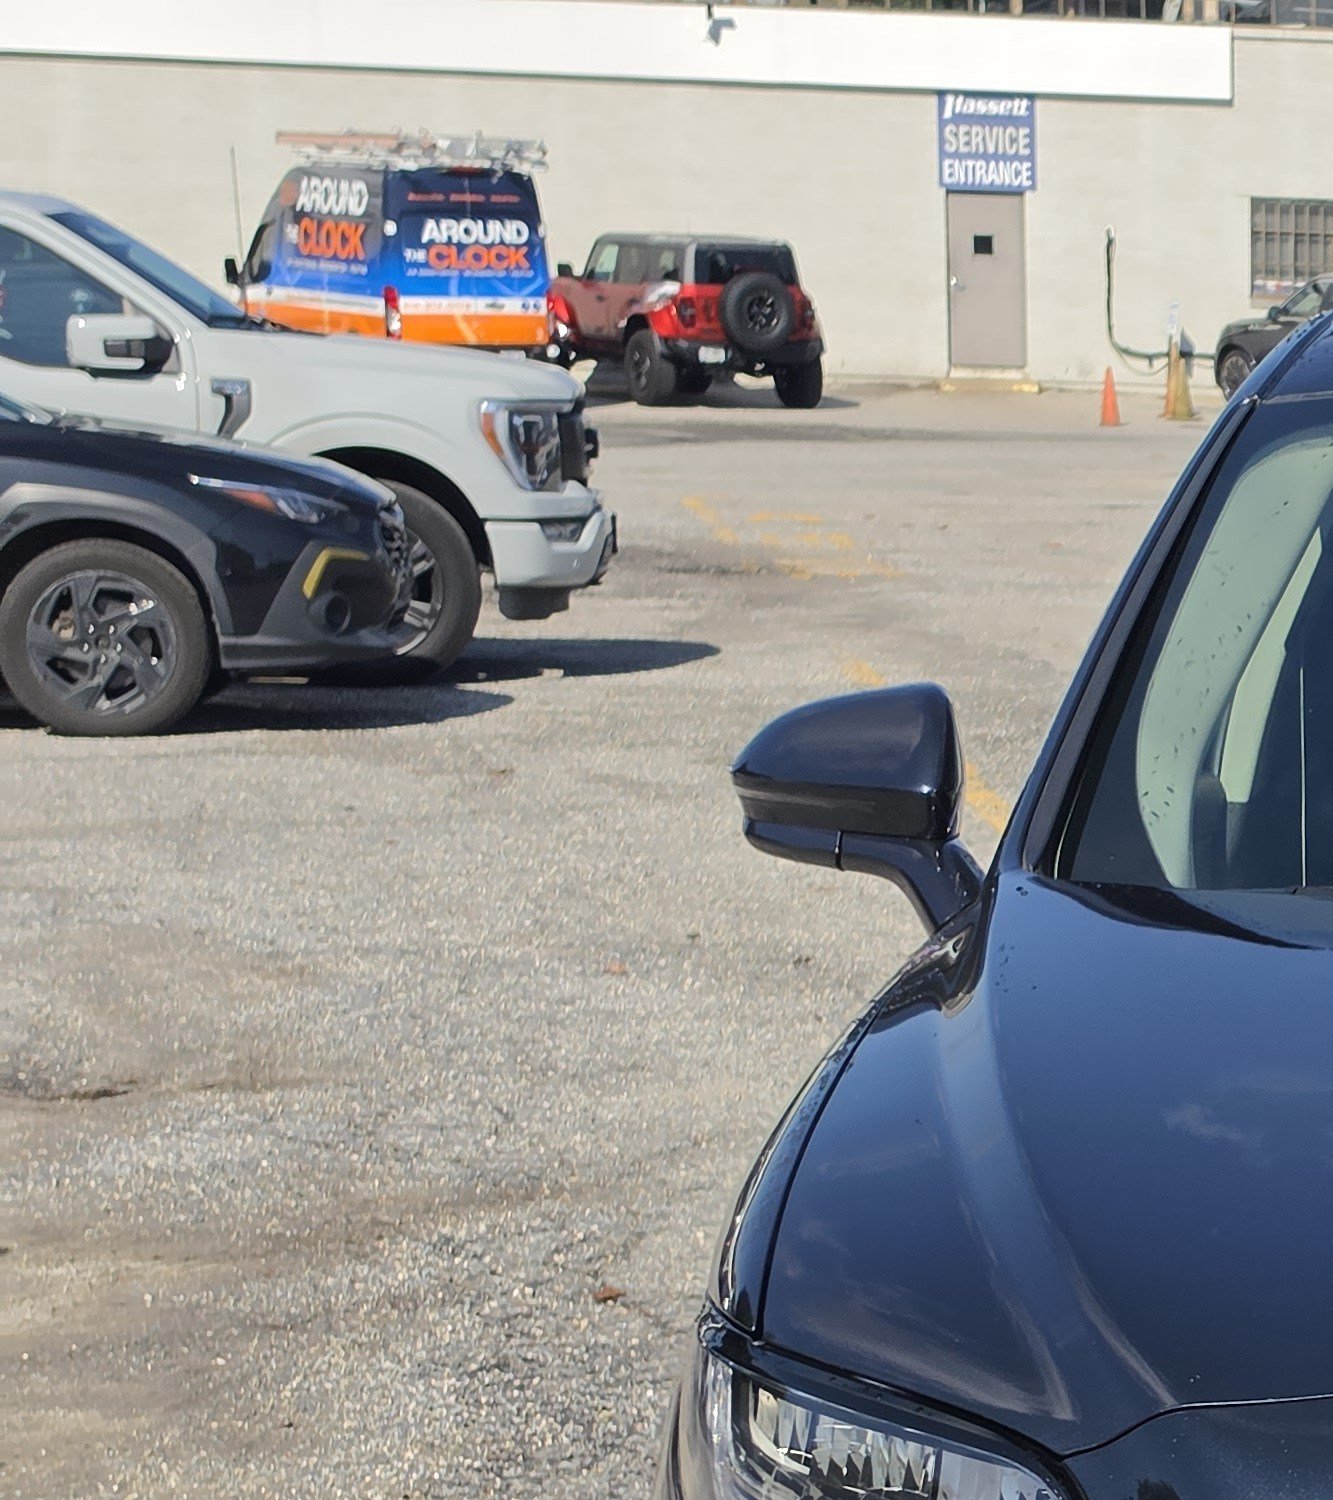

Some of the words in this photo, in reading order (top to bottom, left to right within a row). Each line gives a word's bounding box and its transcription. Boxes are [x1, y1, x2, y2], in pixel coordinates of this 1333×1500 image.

[944, 123, 1031, 156] SERVICE
[942, 158, 1033, 187] ENTRANCE
[295, 175, 369, 216] AROUND
[298, 216, 367, 261] CLOCK
[421, 218, 530, 245] AROUND
[427, 243, 532, 270] CLOCK
